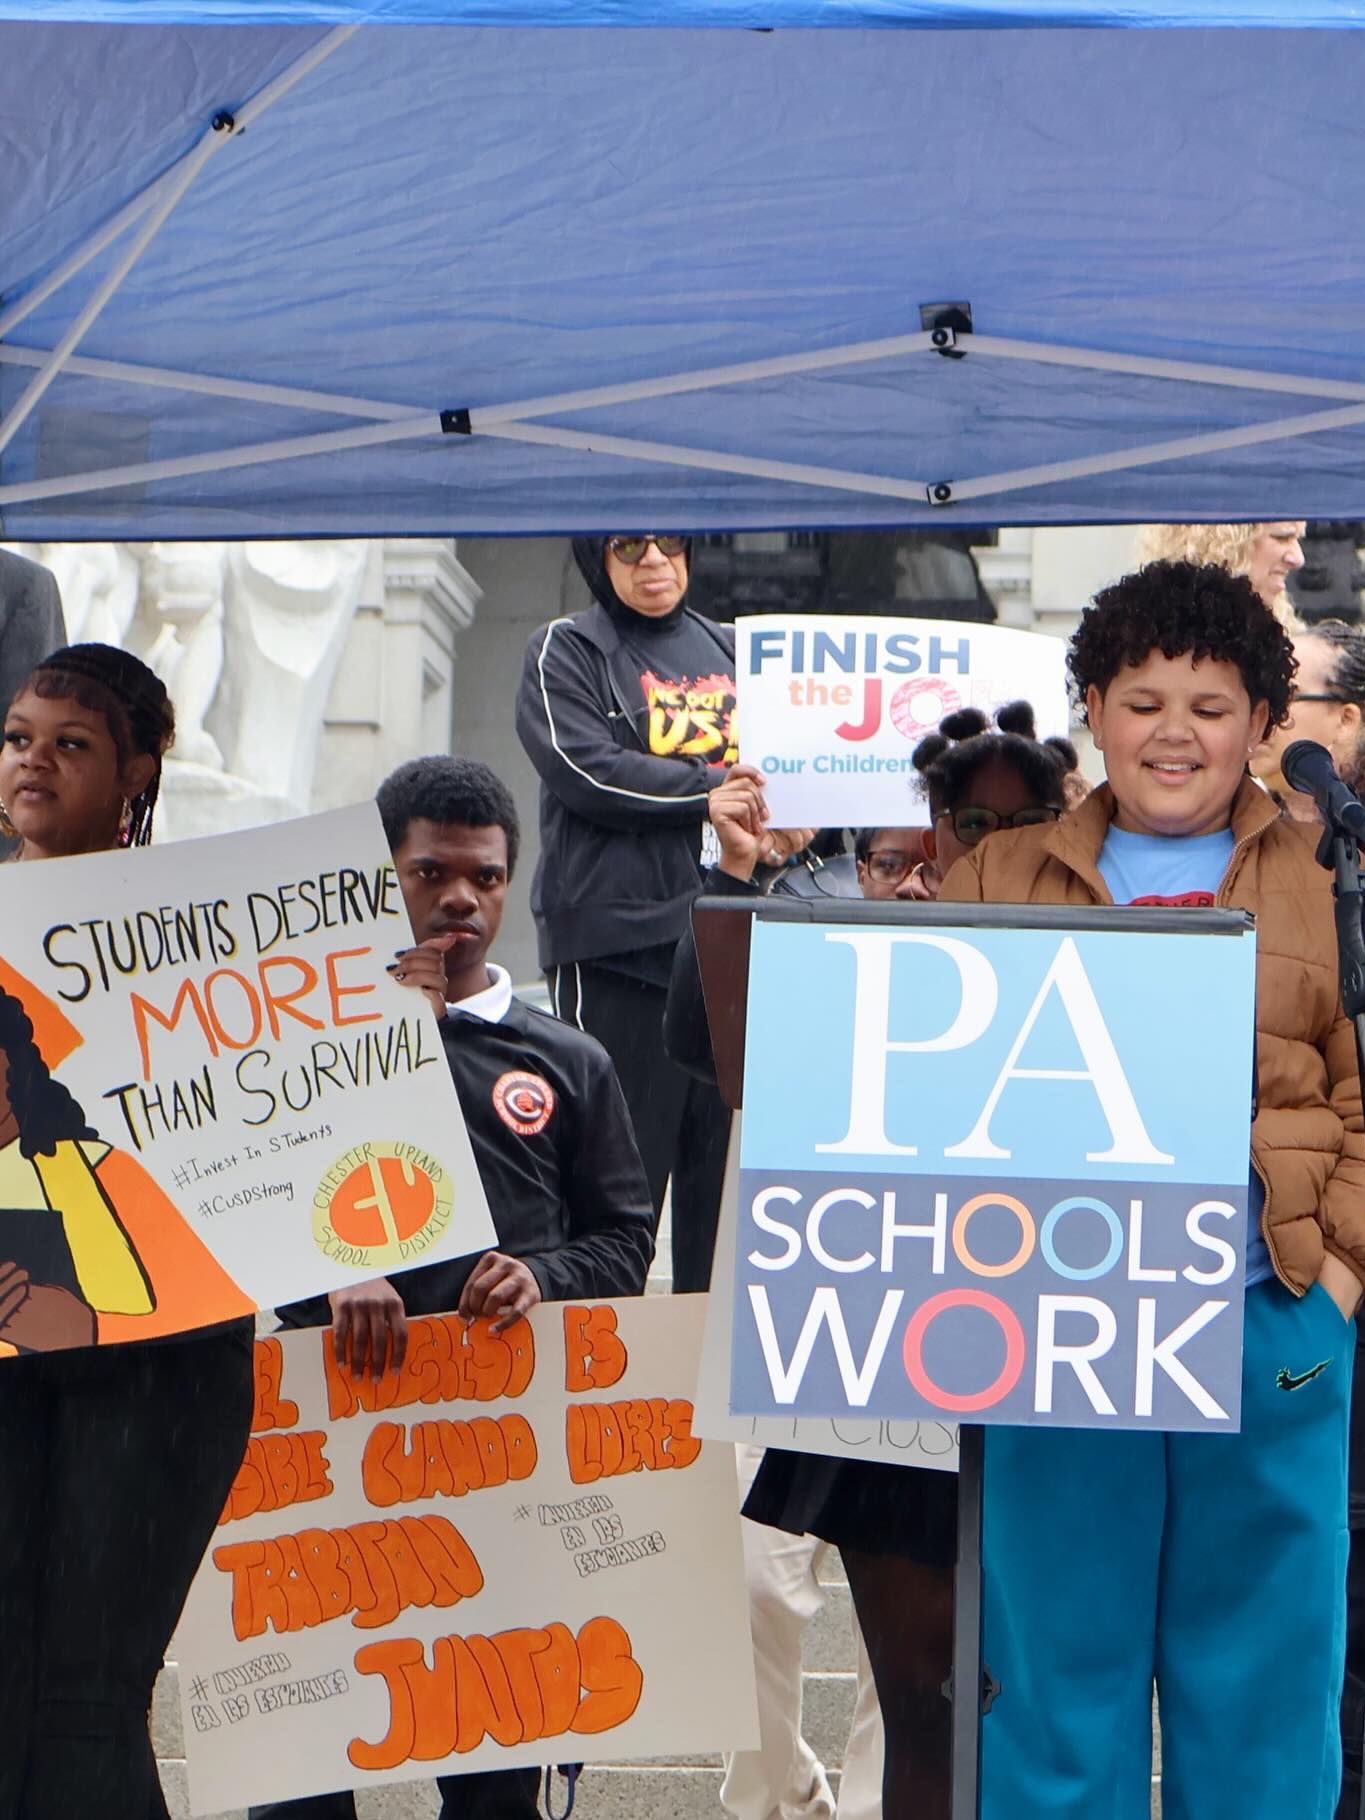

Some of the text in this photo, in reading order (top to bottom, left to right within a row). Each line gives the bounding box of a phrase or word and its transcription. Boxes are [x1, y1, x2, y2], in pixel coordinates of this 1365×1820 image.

[750, 631, 970, 674] FINISH
[788, 680, 853, 706] the
[761, 755, 912, 775] Our Children
[42, 866, 401, 1001] STUDENTS DESERVE
[130, 947, 383, 1081] MORE
[815, 932, 1175, 1165] PA
[102, 1064, 217, 1152] THAN
[235, 1017, 438, 1126] SURVIVAL
[244, 1146, 262, 1160] In
[313, 1141, 443, 1209] CHESTER UPLAND
[314, 1226, 372, 1266] SCHOOL
[747, 1186, 1238, 1286] SCHOOLS
[563, 1305, 628, 1393] ES
[747, 1284, 1231, 1420] WORK
[362, 1414, 538, 1507] CUANDO
[566, 1398, 702, 1485] LIDERES
[213, 1514, 484, 1642] TRABAJAN
[347, 1616, 643, 1770] JUNTOS
